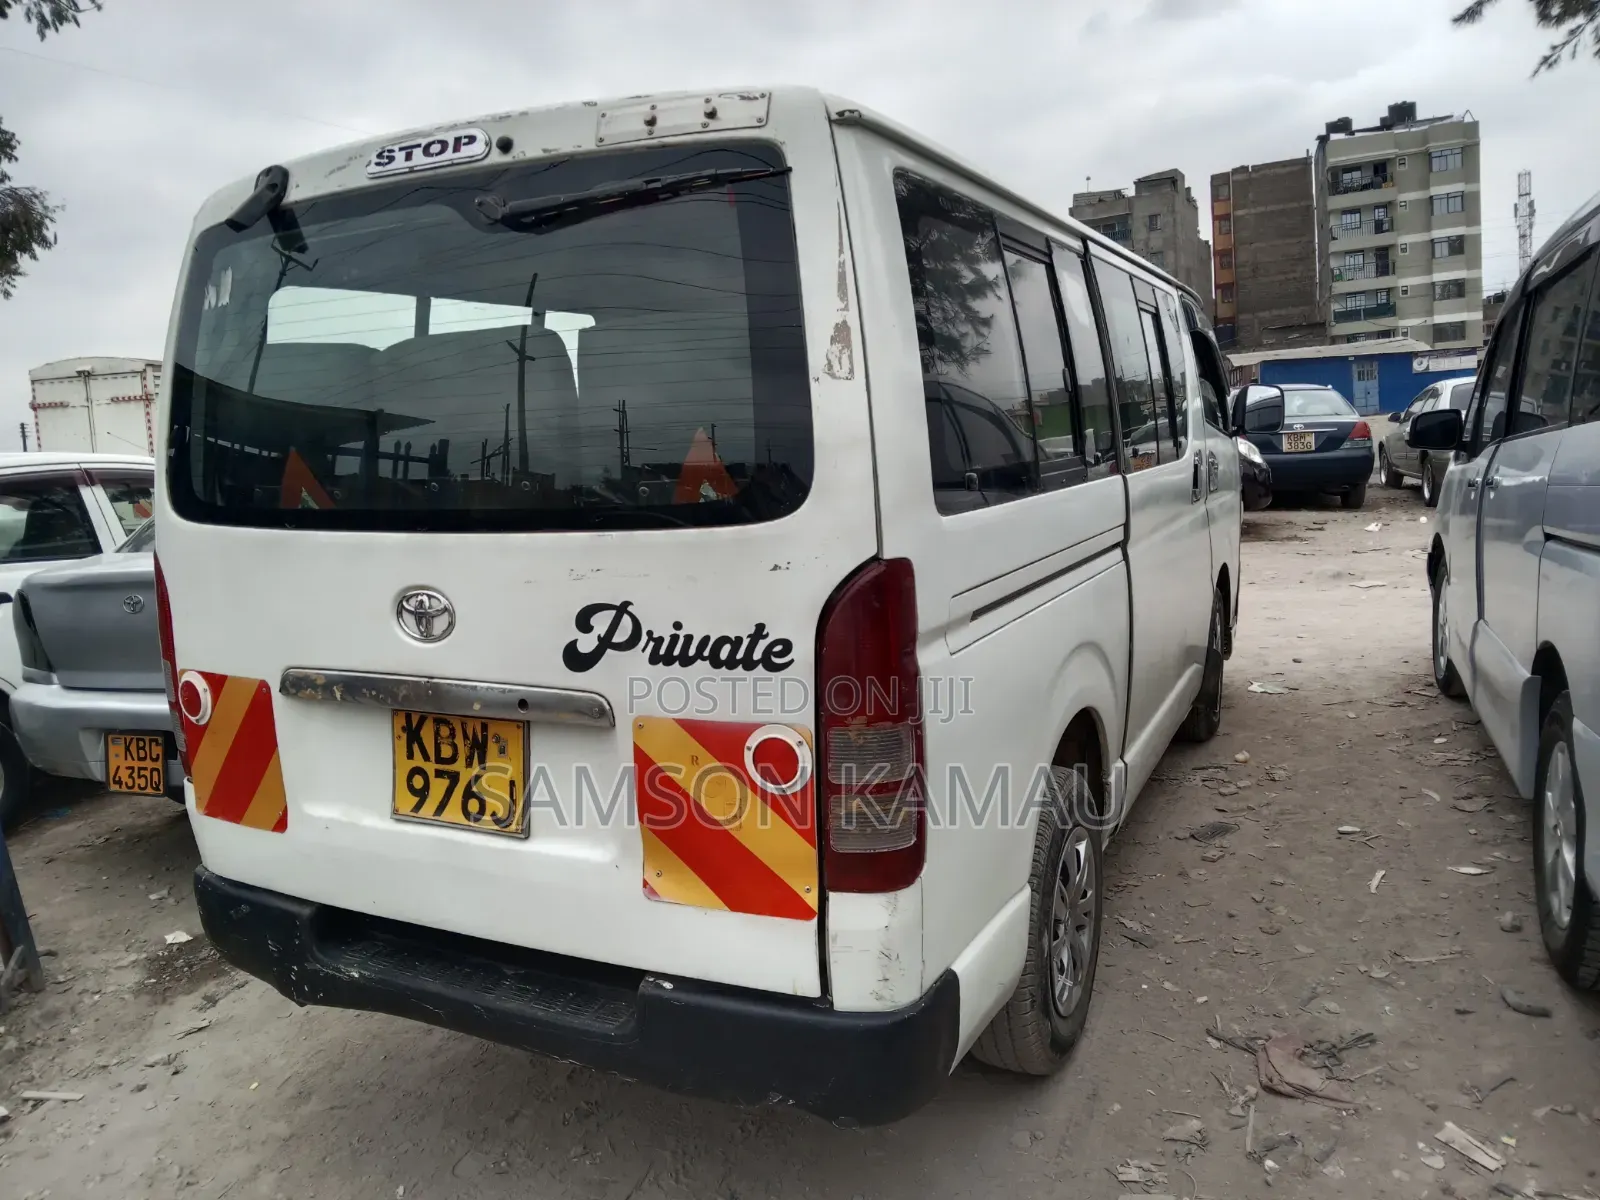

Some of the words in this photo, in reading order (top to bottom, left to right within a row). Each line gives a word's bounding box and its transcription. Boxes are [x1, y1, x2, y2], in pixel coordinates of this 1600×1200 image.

[374, 134, 477, 167] STOP
[1287, 441, 1312, 450] 383G
[562, 600, 795, 673] Private
[124, 737, 162, 762] KBC
[404, 712, 489, 769] KBW
[112, 765, 162, 792] 435Q
